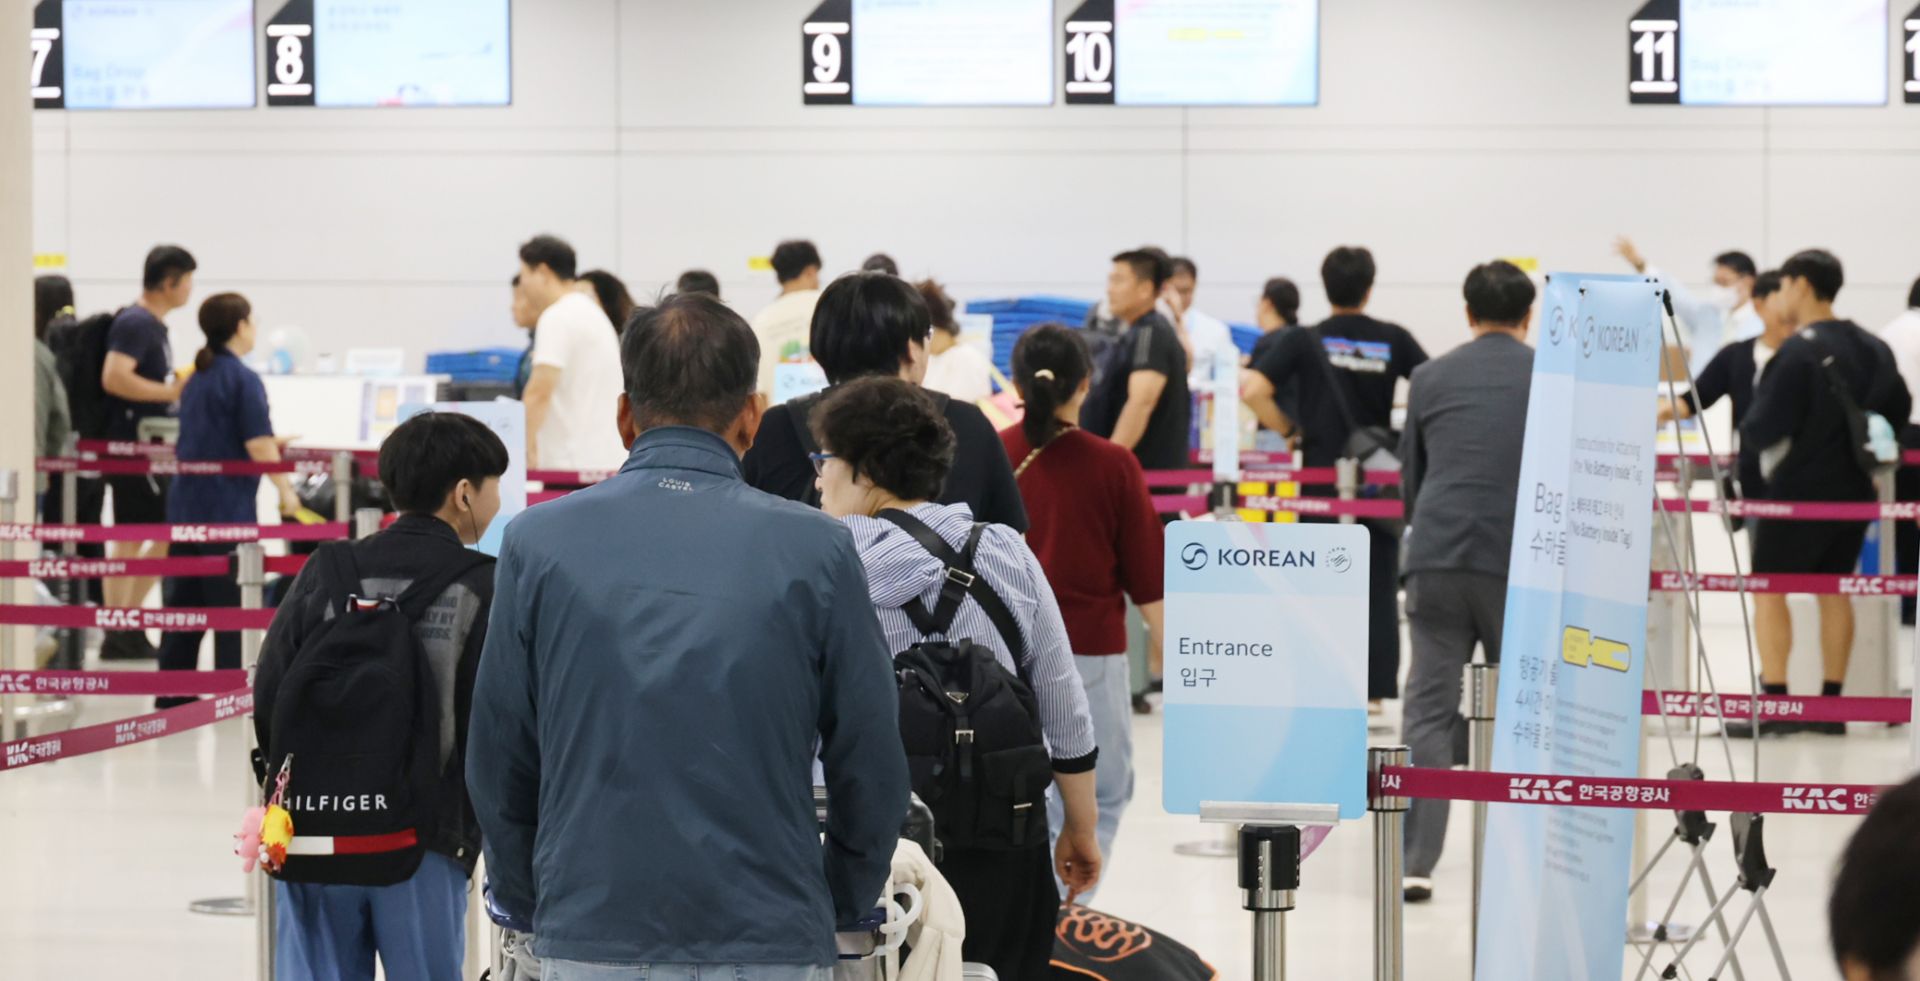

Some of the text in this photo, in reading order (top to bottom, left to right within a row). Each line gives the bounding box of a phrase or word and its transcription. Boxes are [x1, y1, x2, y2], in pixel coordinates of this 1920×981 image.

[31, 40, 52, 87] 7
[275, 34, 304, 85] 8
[811, 32, 842, 84] 9
[1066, 31, 1112, 82] 10
[1633, 31, 1675, 82] 11
[1597, 325, 1640, 353] KOREAN
[1534, 482, 1564, 524] Bag
[171, 525, 207, 540] KAC
[28, 559, 68, 577] KAC
[1218, 548, 1315, 568] KOREAN
[1839, 577, 1883, 593] KAC
[96, 608, 141, 627] KAC
[1179, 637, 1274, 657] Entrance
[0, 673, 32, 692] AC
[1179, 667, 1218, 688] 입구
[1663, 694, 1720, 716] KAC
[1508, 777, 1670, 803] KAC 한국공항공사
[1782, 786, 1848, 811] KAC
